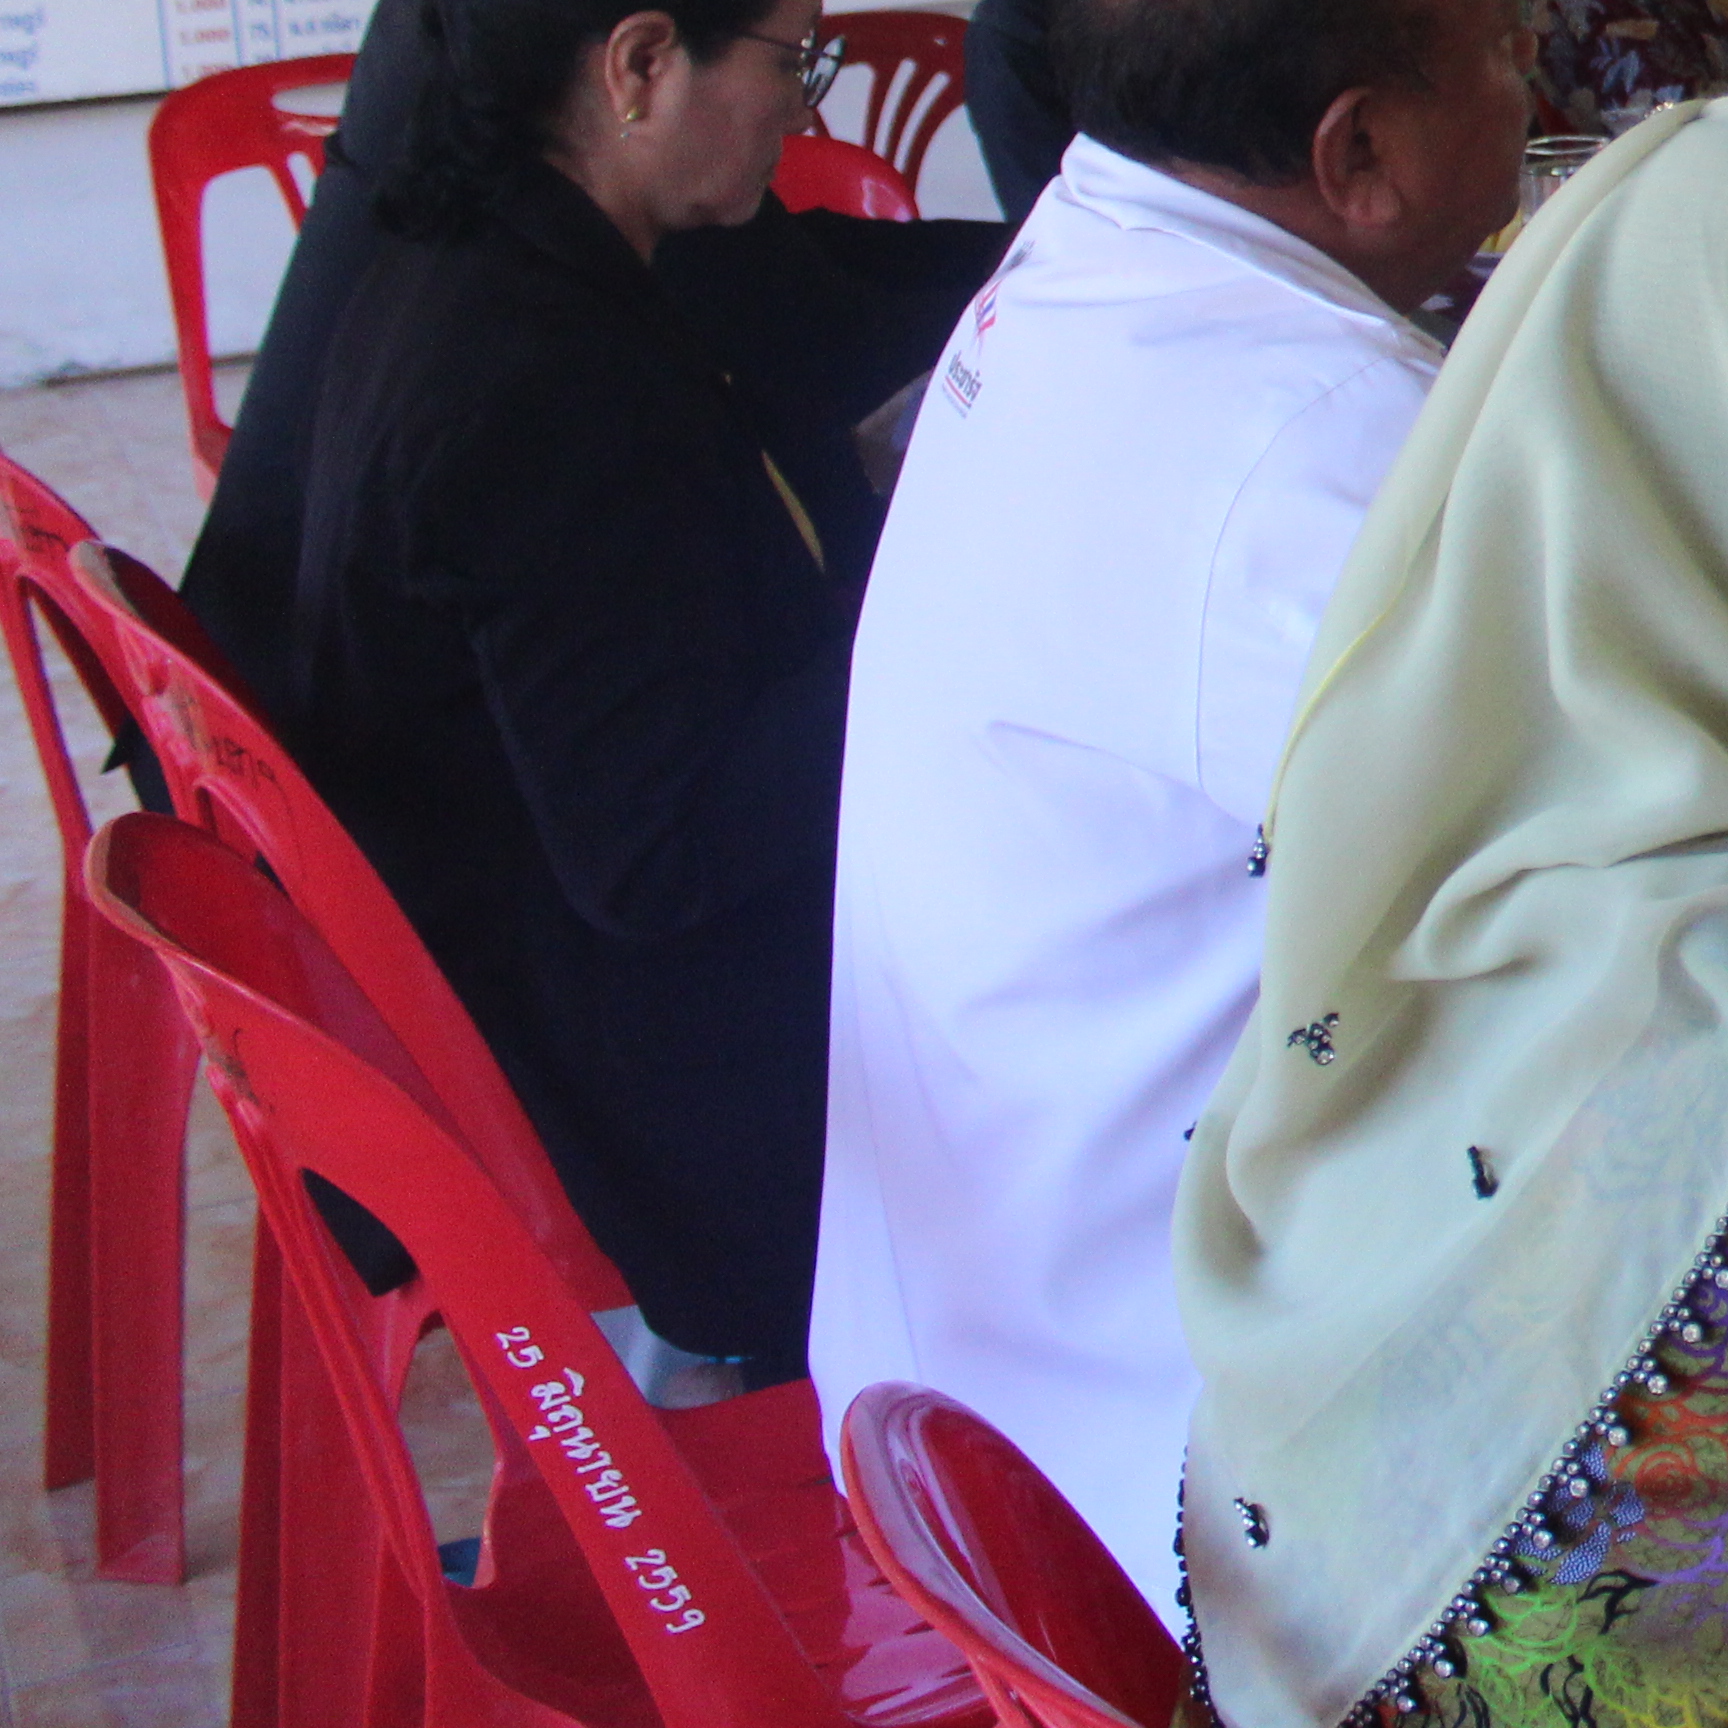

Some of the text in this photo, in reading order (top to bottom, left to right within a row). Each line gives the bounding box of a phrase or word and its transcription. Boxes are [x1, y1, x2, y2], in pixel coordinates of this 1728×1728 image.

[495, 1325, 707, 1636] 25 มิถุนายน 2559
